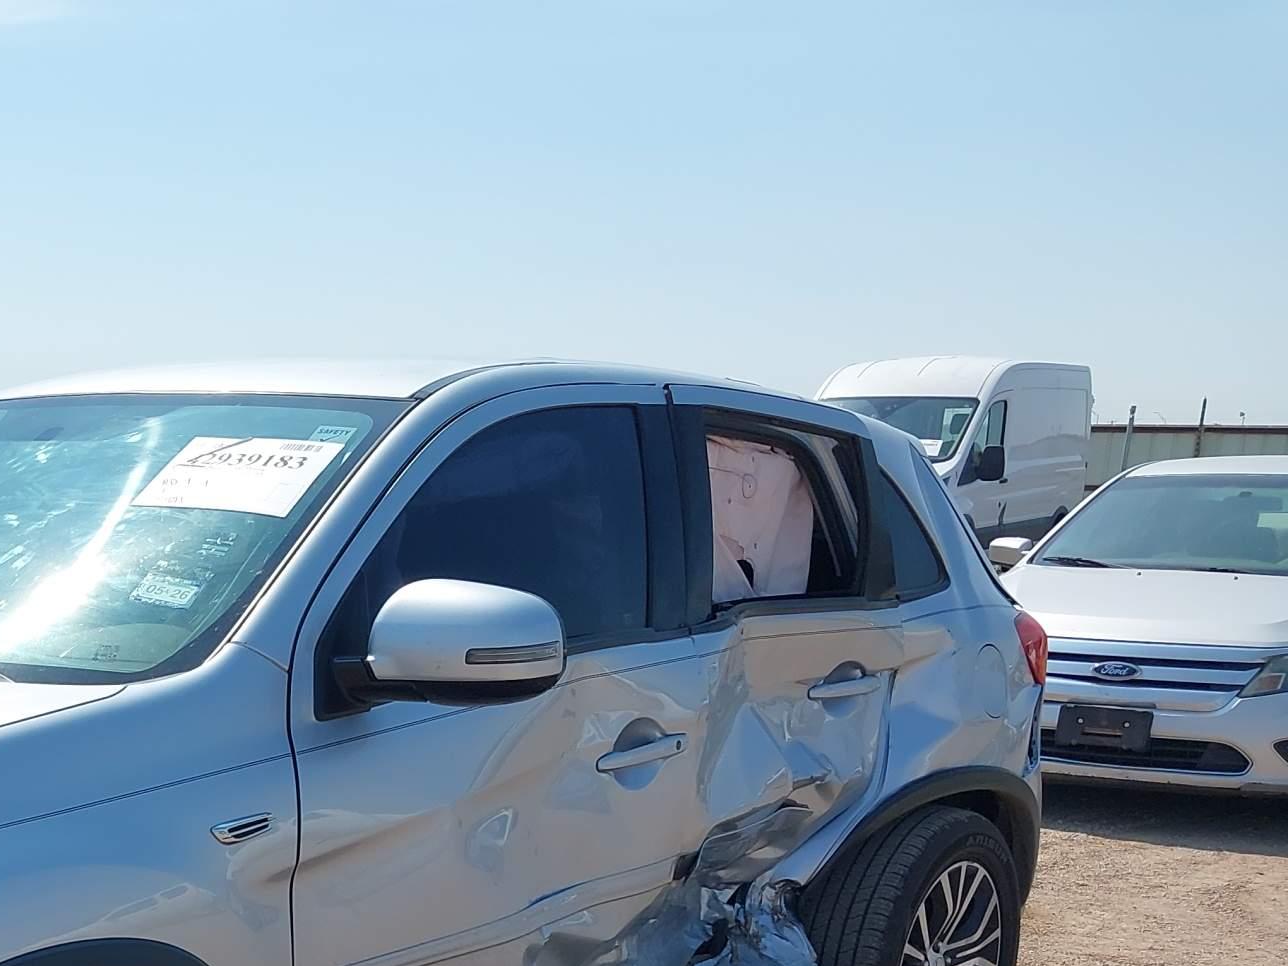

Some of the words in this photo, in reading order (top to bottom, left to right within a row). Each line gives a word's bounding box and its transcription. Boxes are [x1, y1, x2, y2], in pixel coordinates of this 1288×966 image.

[316, 429, 352, 437] SAFETY
[145, 584, 166, 595] 05
[170, 588, 192, 600] 26
[1100, 663, 1129, 676] Ford
